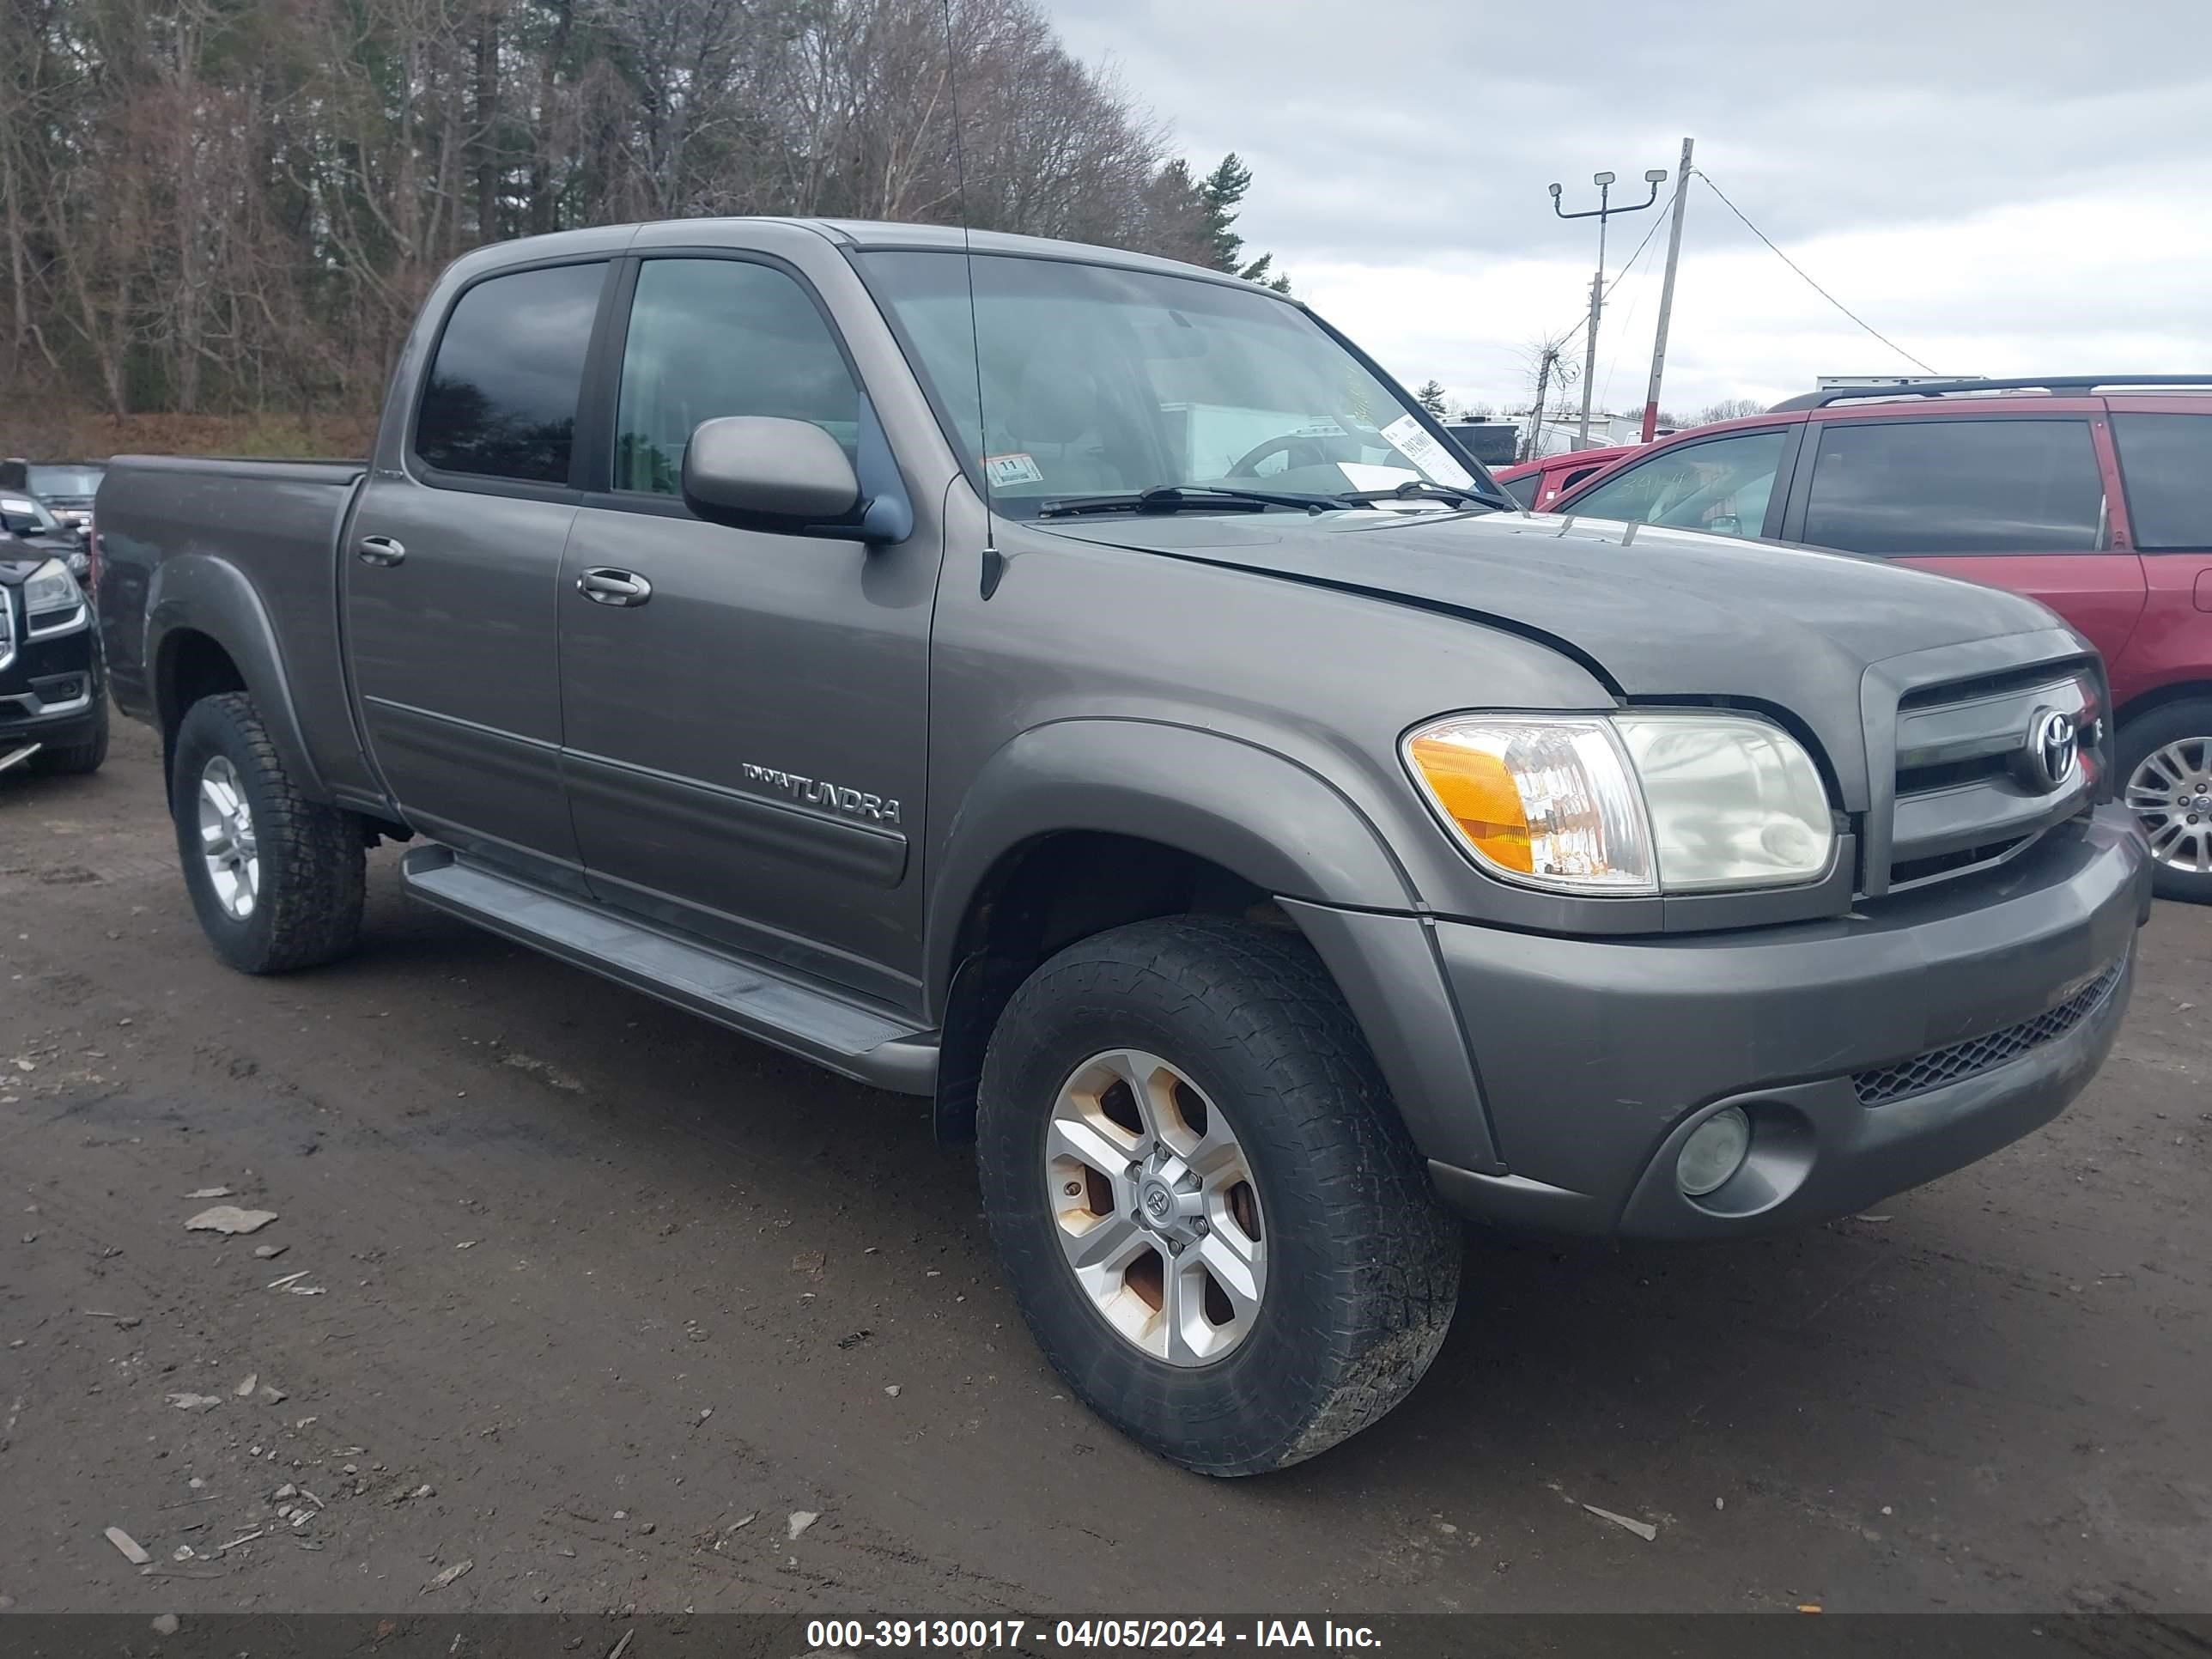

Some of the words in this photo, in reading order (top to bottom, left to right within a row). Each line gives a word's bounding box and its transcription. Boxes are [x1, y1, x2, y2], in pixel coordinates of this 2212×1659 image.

[1000, 459, 1017, 471] 11
[742, 763, 789, 788] TOYOTA
[788, 775, 901, 823] TUNDRA
